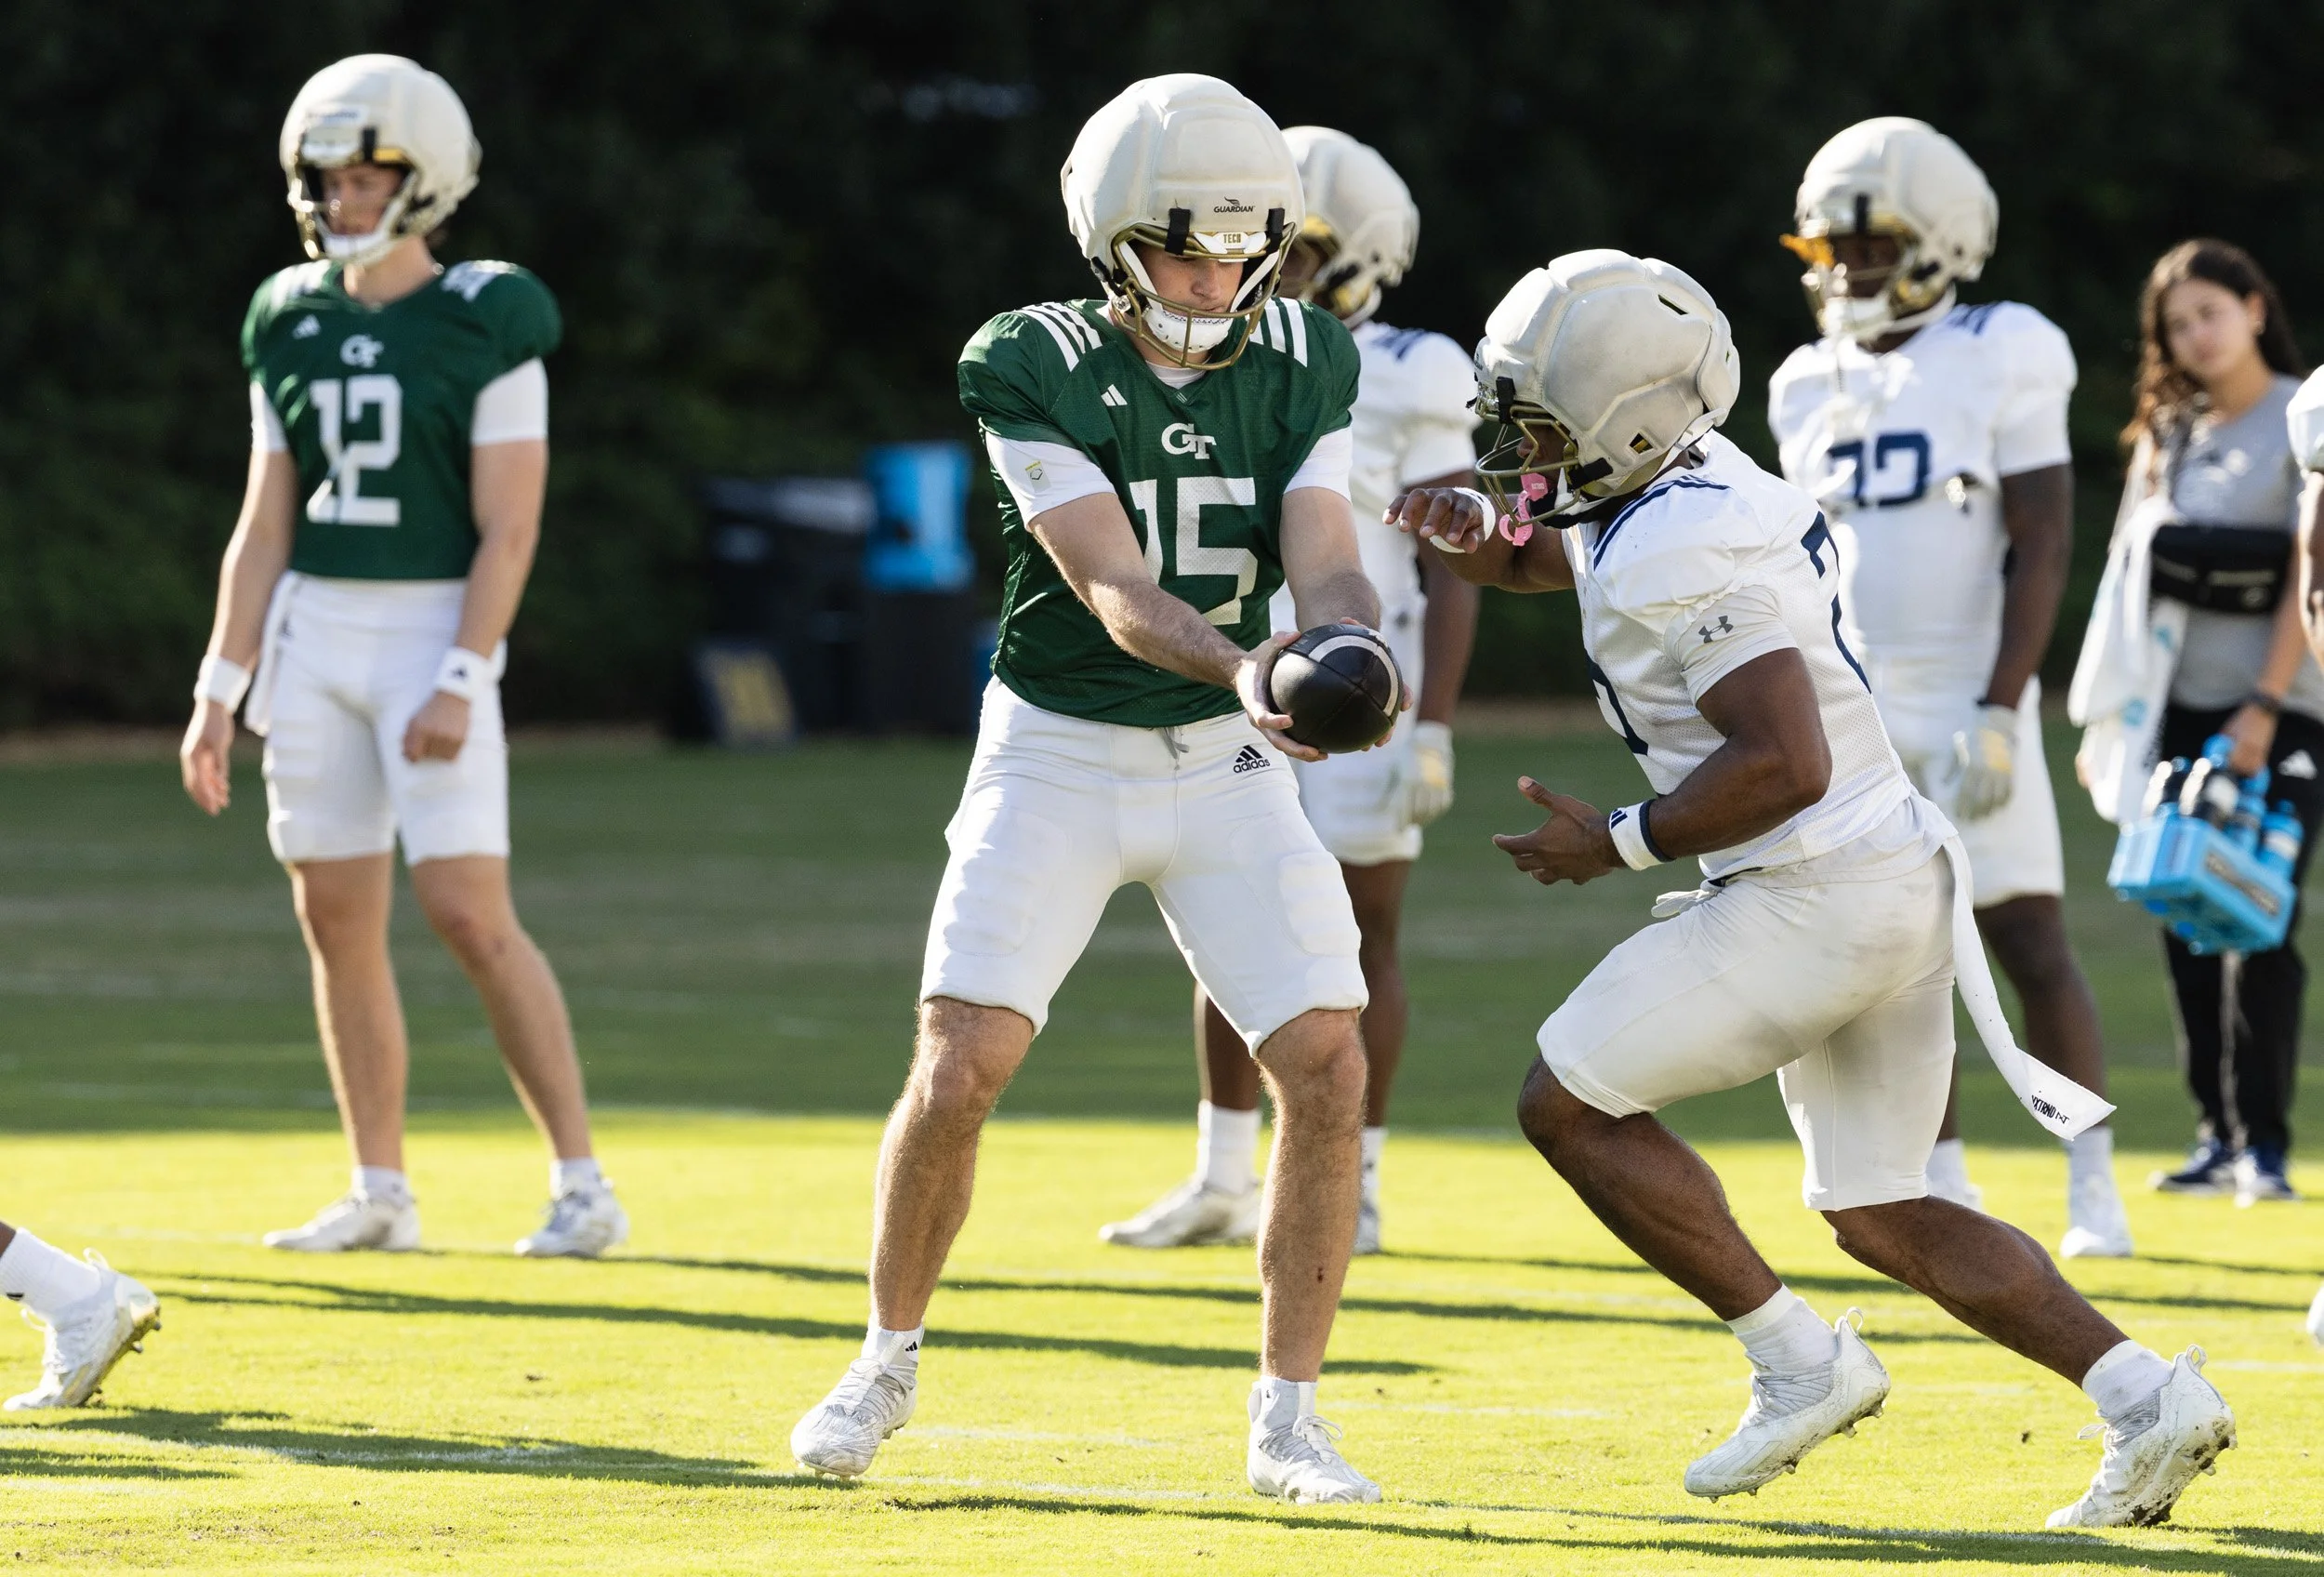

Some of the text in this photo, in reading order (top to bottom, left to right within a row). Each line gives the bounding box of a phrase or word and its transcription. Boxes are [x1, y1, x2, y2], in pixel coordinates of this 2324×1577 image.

[1223, 233, 1241, 244] TECH
[307, 374, 403, 526] 12
[1161, 422, 1217, 459] GT
[1129, 475, 1259, 626] 15
[1233, 758, 1271, 774] adidas
